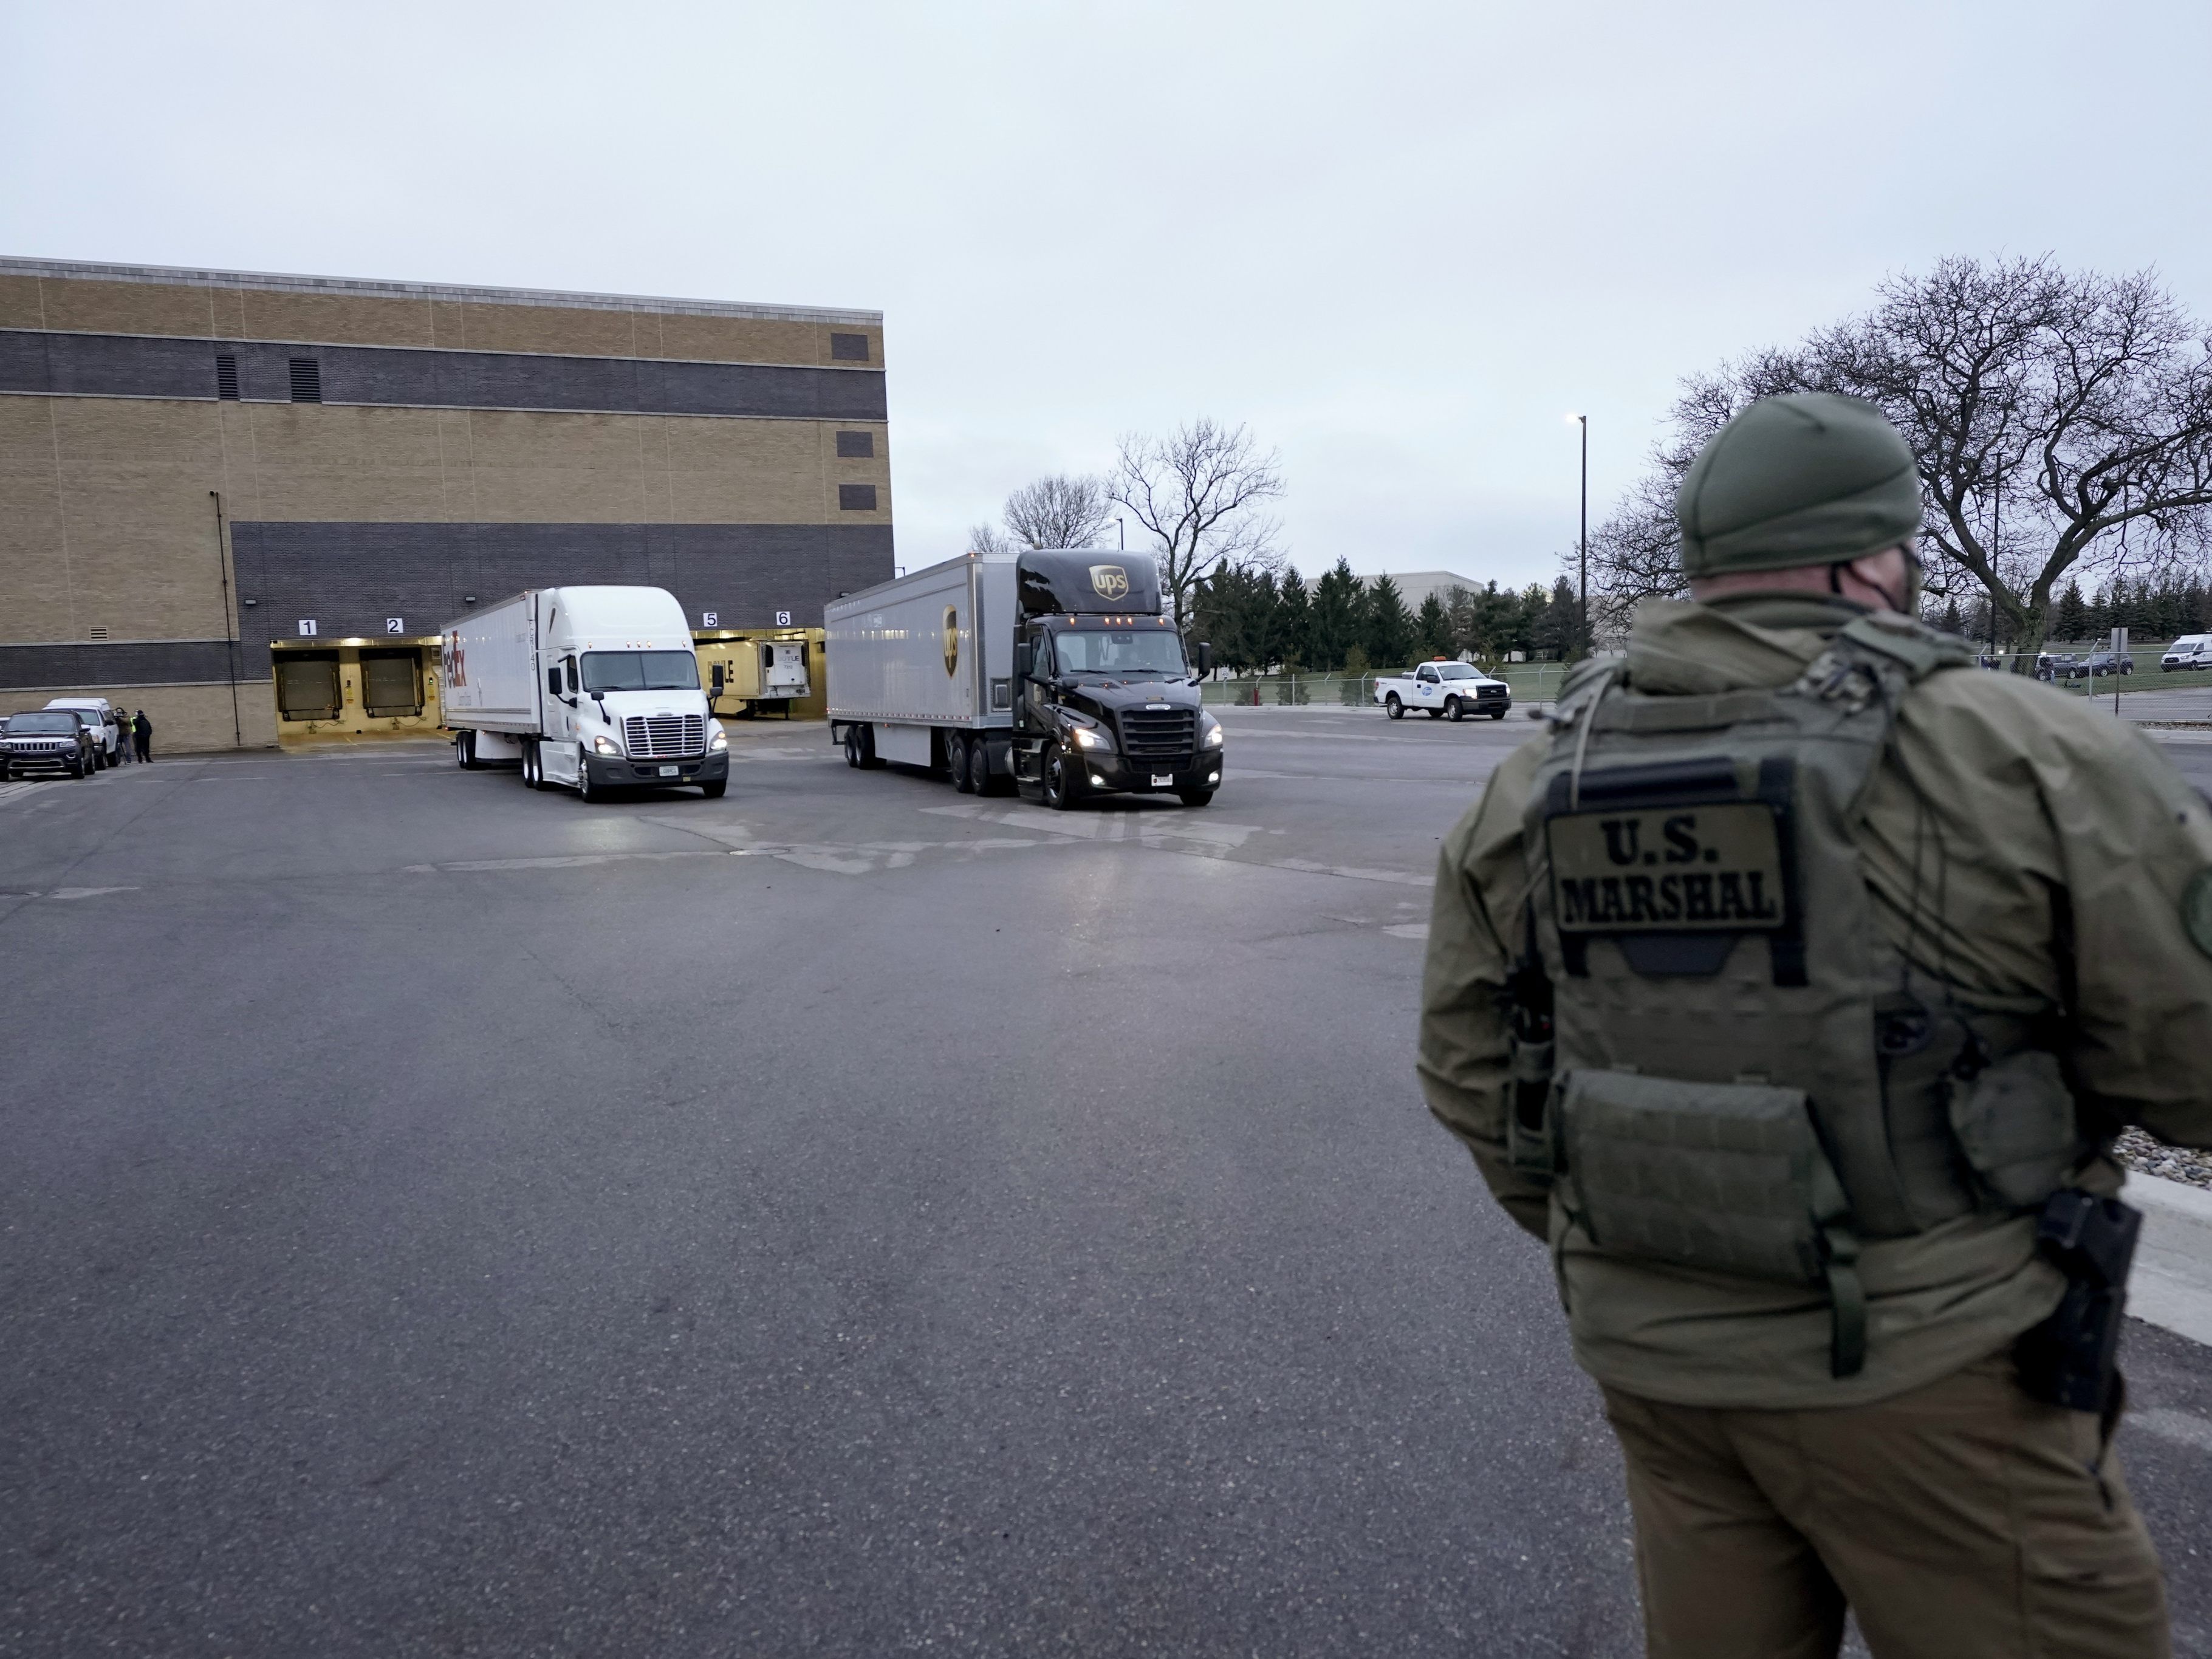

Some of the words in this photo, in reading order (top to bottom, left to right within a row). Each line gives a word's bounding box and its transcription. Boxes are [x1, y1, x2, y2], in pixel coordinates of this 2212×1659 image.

[1094, 574, 1126, 595] ups
[304, 621, 310, 634] 1
[389, 620, 399, 632] 2
[707, 614, 716, 626] 5
[779, 612, 788, 624] 6
[944, 628, 957, 668] ups
[708, 660, 734, 683] BLE
[1600, 815, 1719, 866] U.S.
[1561, 871, 1776, 922] MARSHAL
